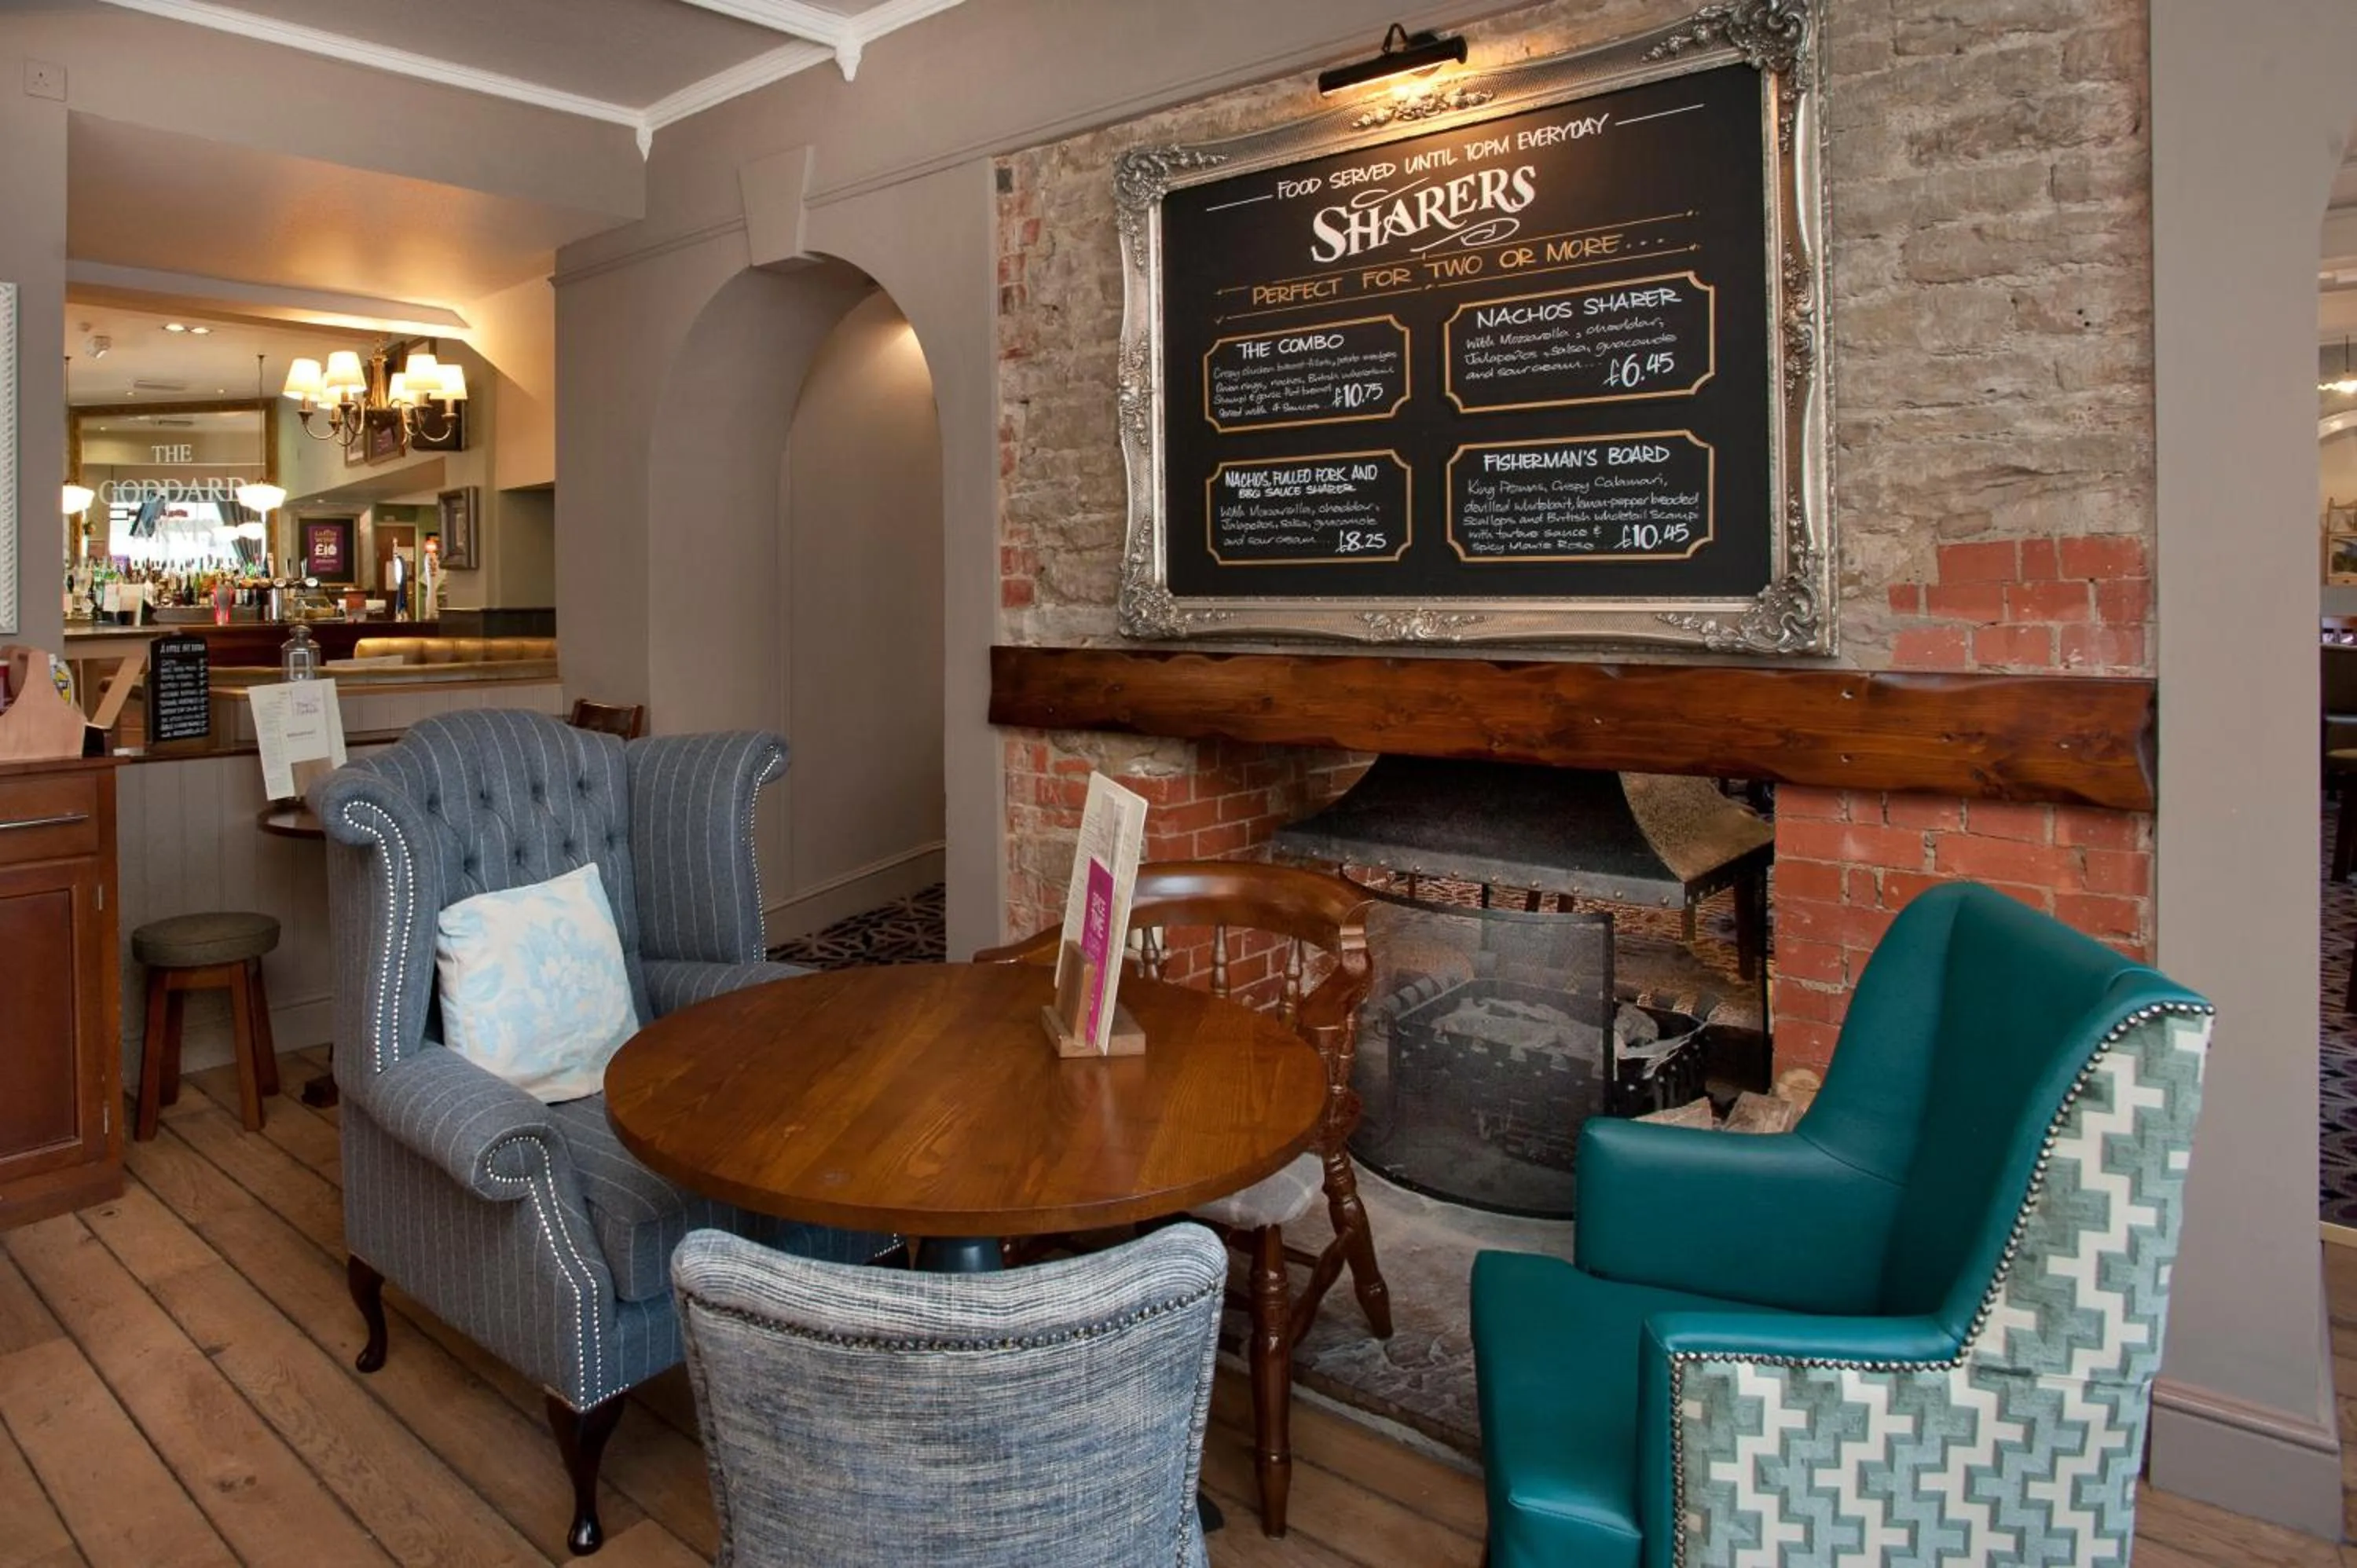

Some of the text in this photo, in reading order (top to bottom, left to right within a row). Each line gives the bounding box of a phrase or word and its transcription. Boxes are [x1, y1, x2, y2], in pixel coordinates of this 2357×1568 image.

[1277, 112, 1611, 200] FOOD SERVED UNTIL 10PM EVERYDAY
[1311, 164, 1537, 263] SHARERS
[1252, 276, 1342, 305] PERFECT
[1362, 266, 1411, 290] FOR
[1423, 252, 1483, 280] TWO
[1500, 244, 1535, 269] OR
[1477, 288, 1682, 329] NACHOS SHARER
[1236, 334, 1344, 359] THE COMBO
[1602, 352, 1675, 387] £6.45
[1332, 383, 1384, 408] £10.75
[151, 444, 192, 463] THE
[1483, 445, 1670, 471] FISHERMAN'S BOARD
[1225, 464, 1377, 487] NACHOS, PULLED PORK AND
[1239, 483, 1357, 499] BBQ SAUCE SHARER
[1335, 529, 1387, 553] £8.25
[1614, 522, 1689, 549] £10.45
